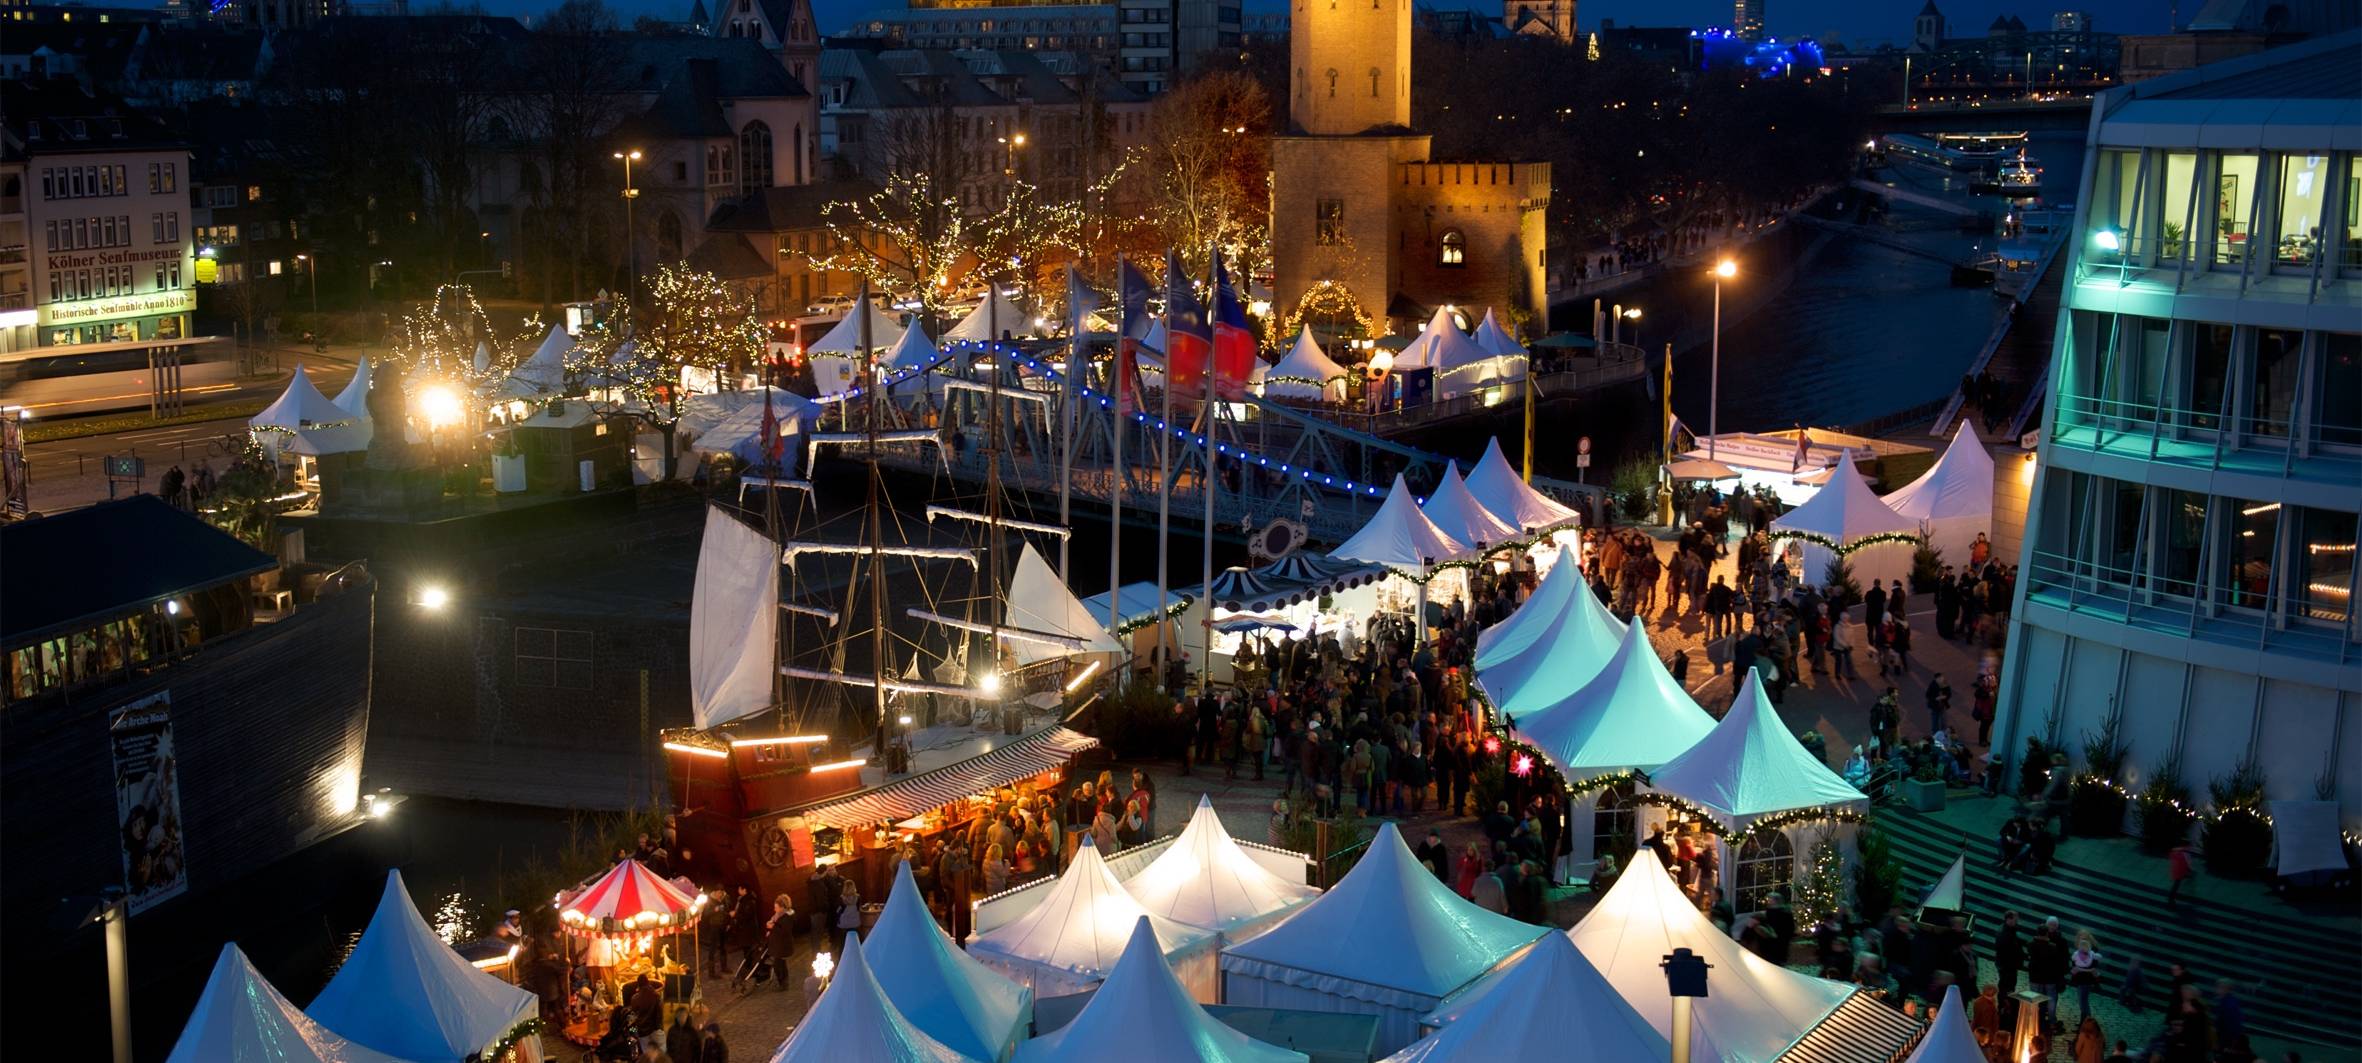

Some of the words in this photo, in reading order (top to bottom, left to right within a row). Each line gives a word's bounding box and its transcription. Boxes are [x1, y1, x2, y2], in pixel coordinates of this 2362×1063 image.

[48, 253, 95, 269] Kölner
[99, 249, 182, 265] Senfmuseum
[52, 306, 98, 320] Historische
[100, 301, 143, 315] Senfmühle
[143, 300, 165, 311] Anno
[166, 297, 185, 308] 1810
[128, 715, 150, 727] Arche
